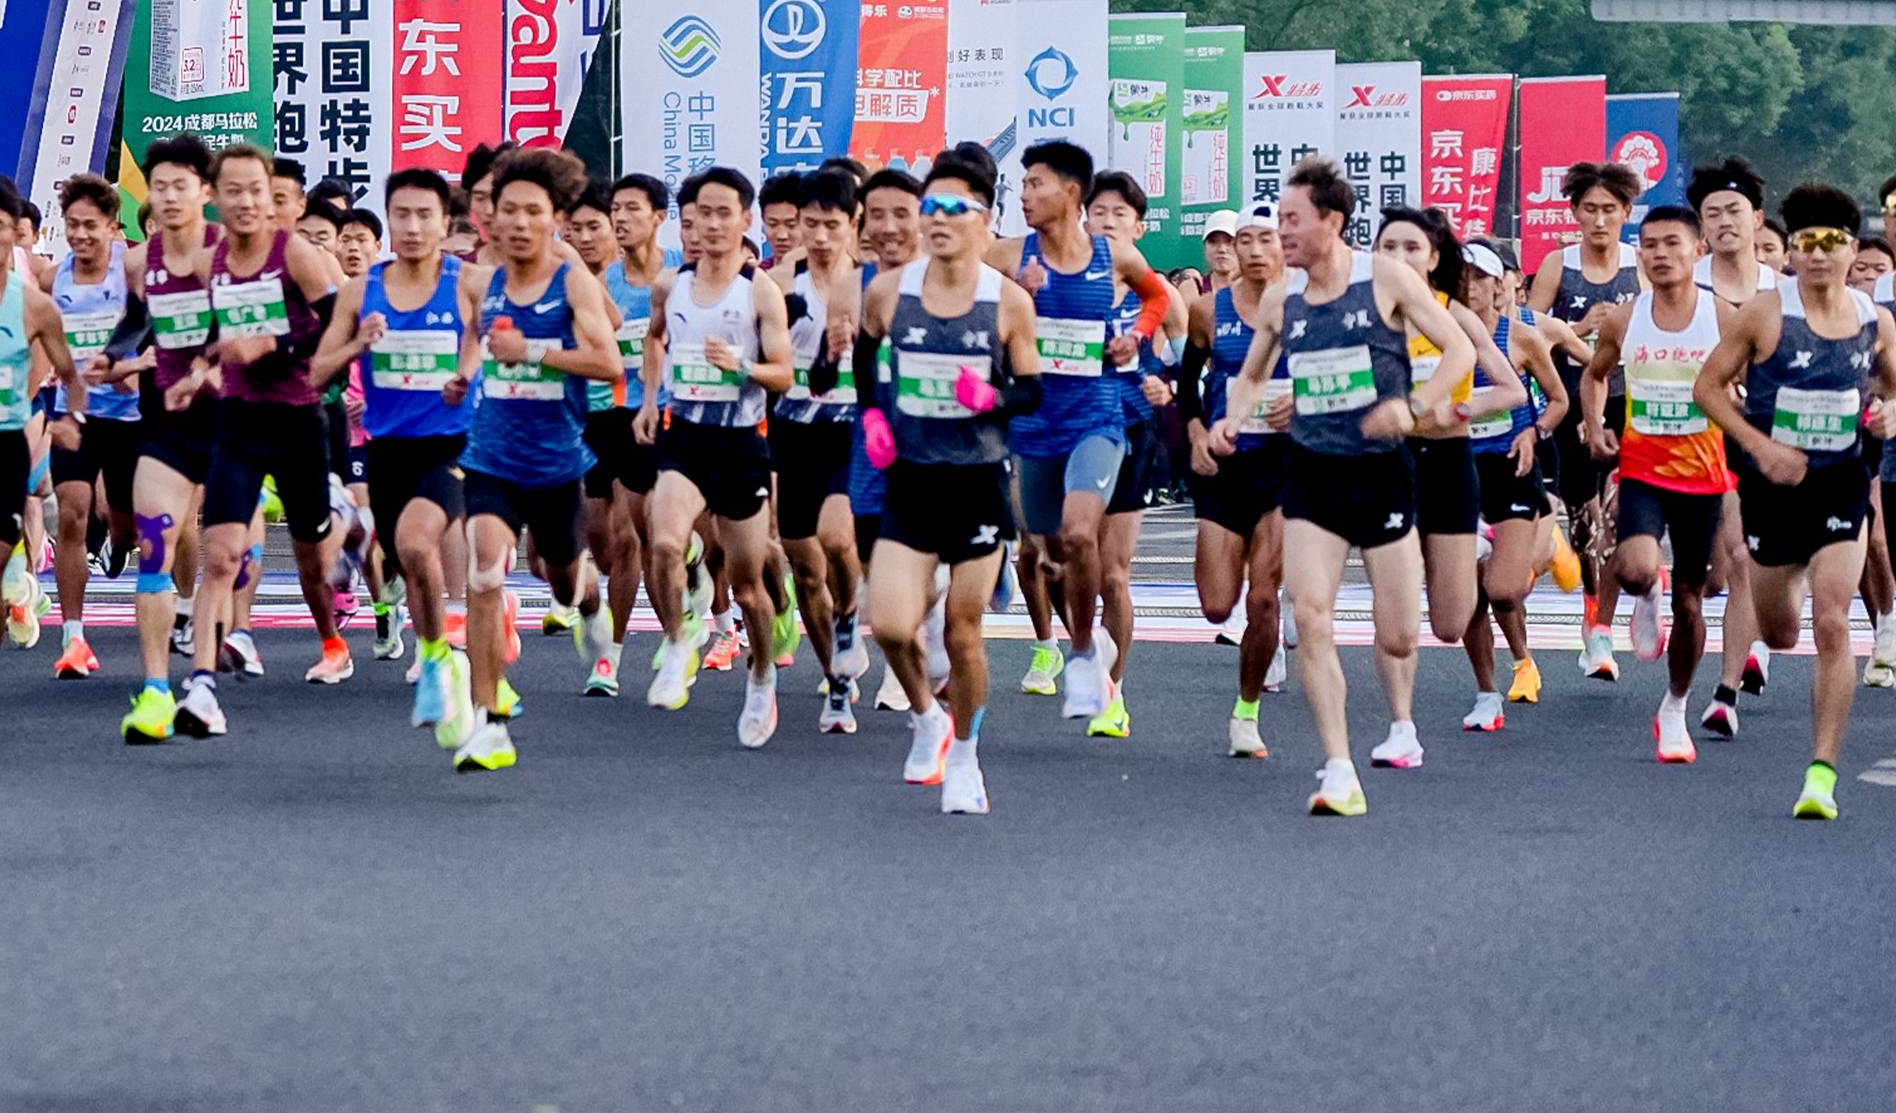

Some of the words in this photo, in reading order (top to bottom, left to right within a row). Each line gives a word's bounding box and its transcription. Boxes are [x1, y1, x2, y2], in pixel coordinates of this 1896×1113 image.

[141, 111, 258, 133] 2024成都马拉松
[663, 91, 683, 150] China
[1028, 107, 1074, 128] NCI
